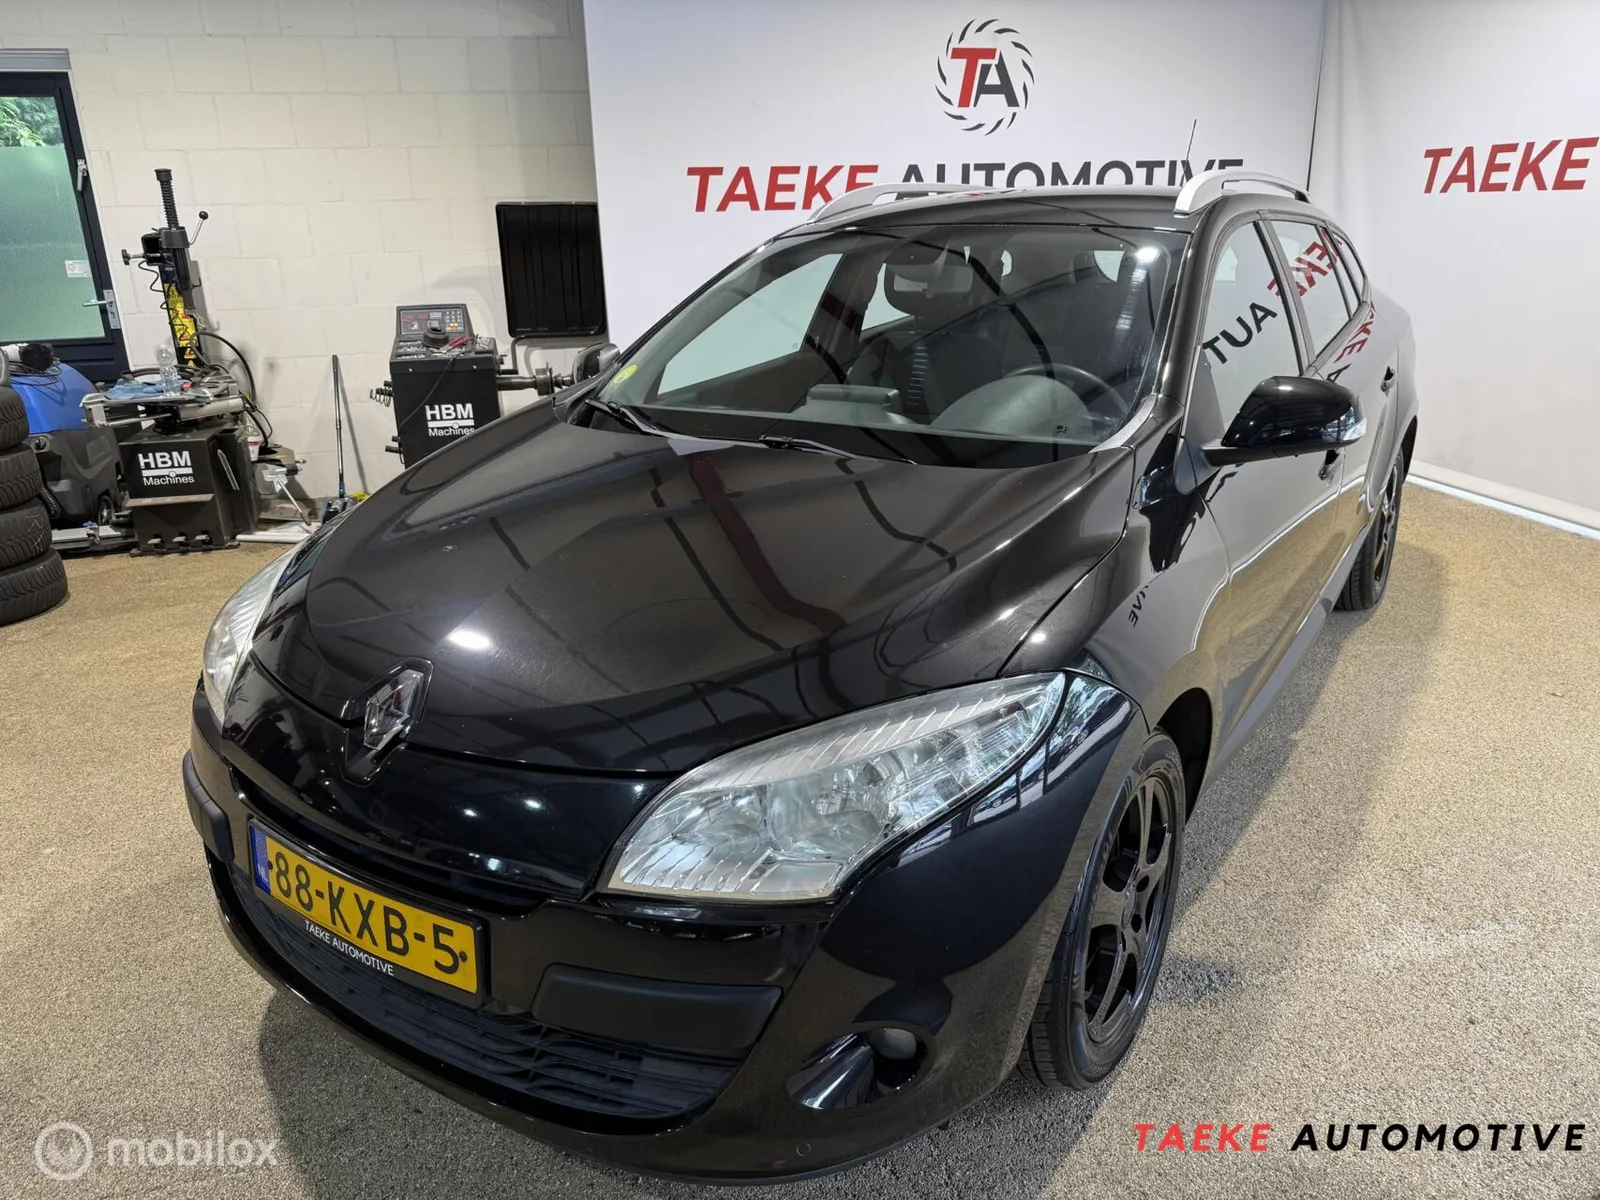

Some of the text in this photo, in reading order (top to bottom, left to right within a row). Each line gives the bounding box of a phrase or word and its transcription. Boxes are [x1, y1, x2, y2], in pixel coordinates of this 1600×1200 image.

[951, 47, 1020, 108] TA
[687, 158, 1244, 212] TAEKE ATOMOTI
[1424, 137, 1600, 194] TAEKE
[425, 403, 474, 420] HBM
[428, 427, 475, 437] Machines
[138, 450, 192, 469] HBM
[143, 475, 195, 486] Machines
[275, 852, 460, 975] 88-KXB-5
[304, 920, 395, 976] TAEKE AUTOMOTIVE
